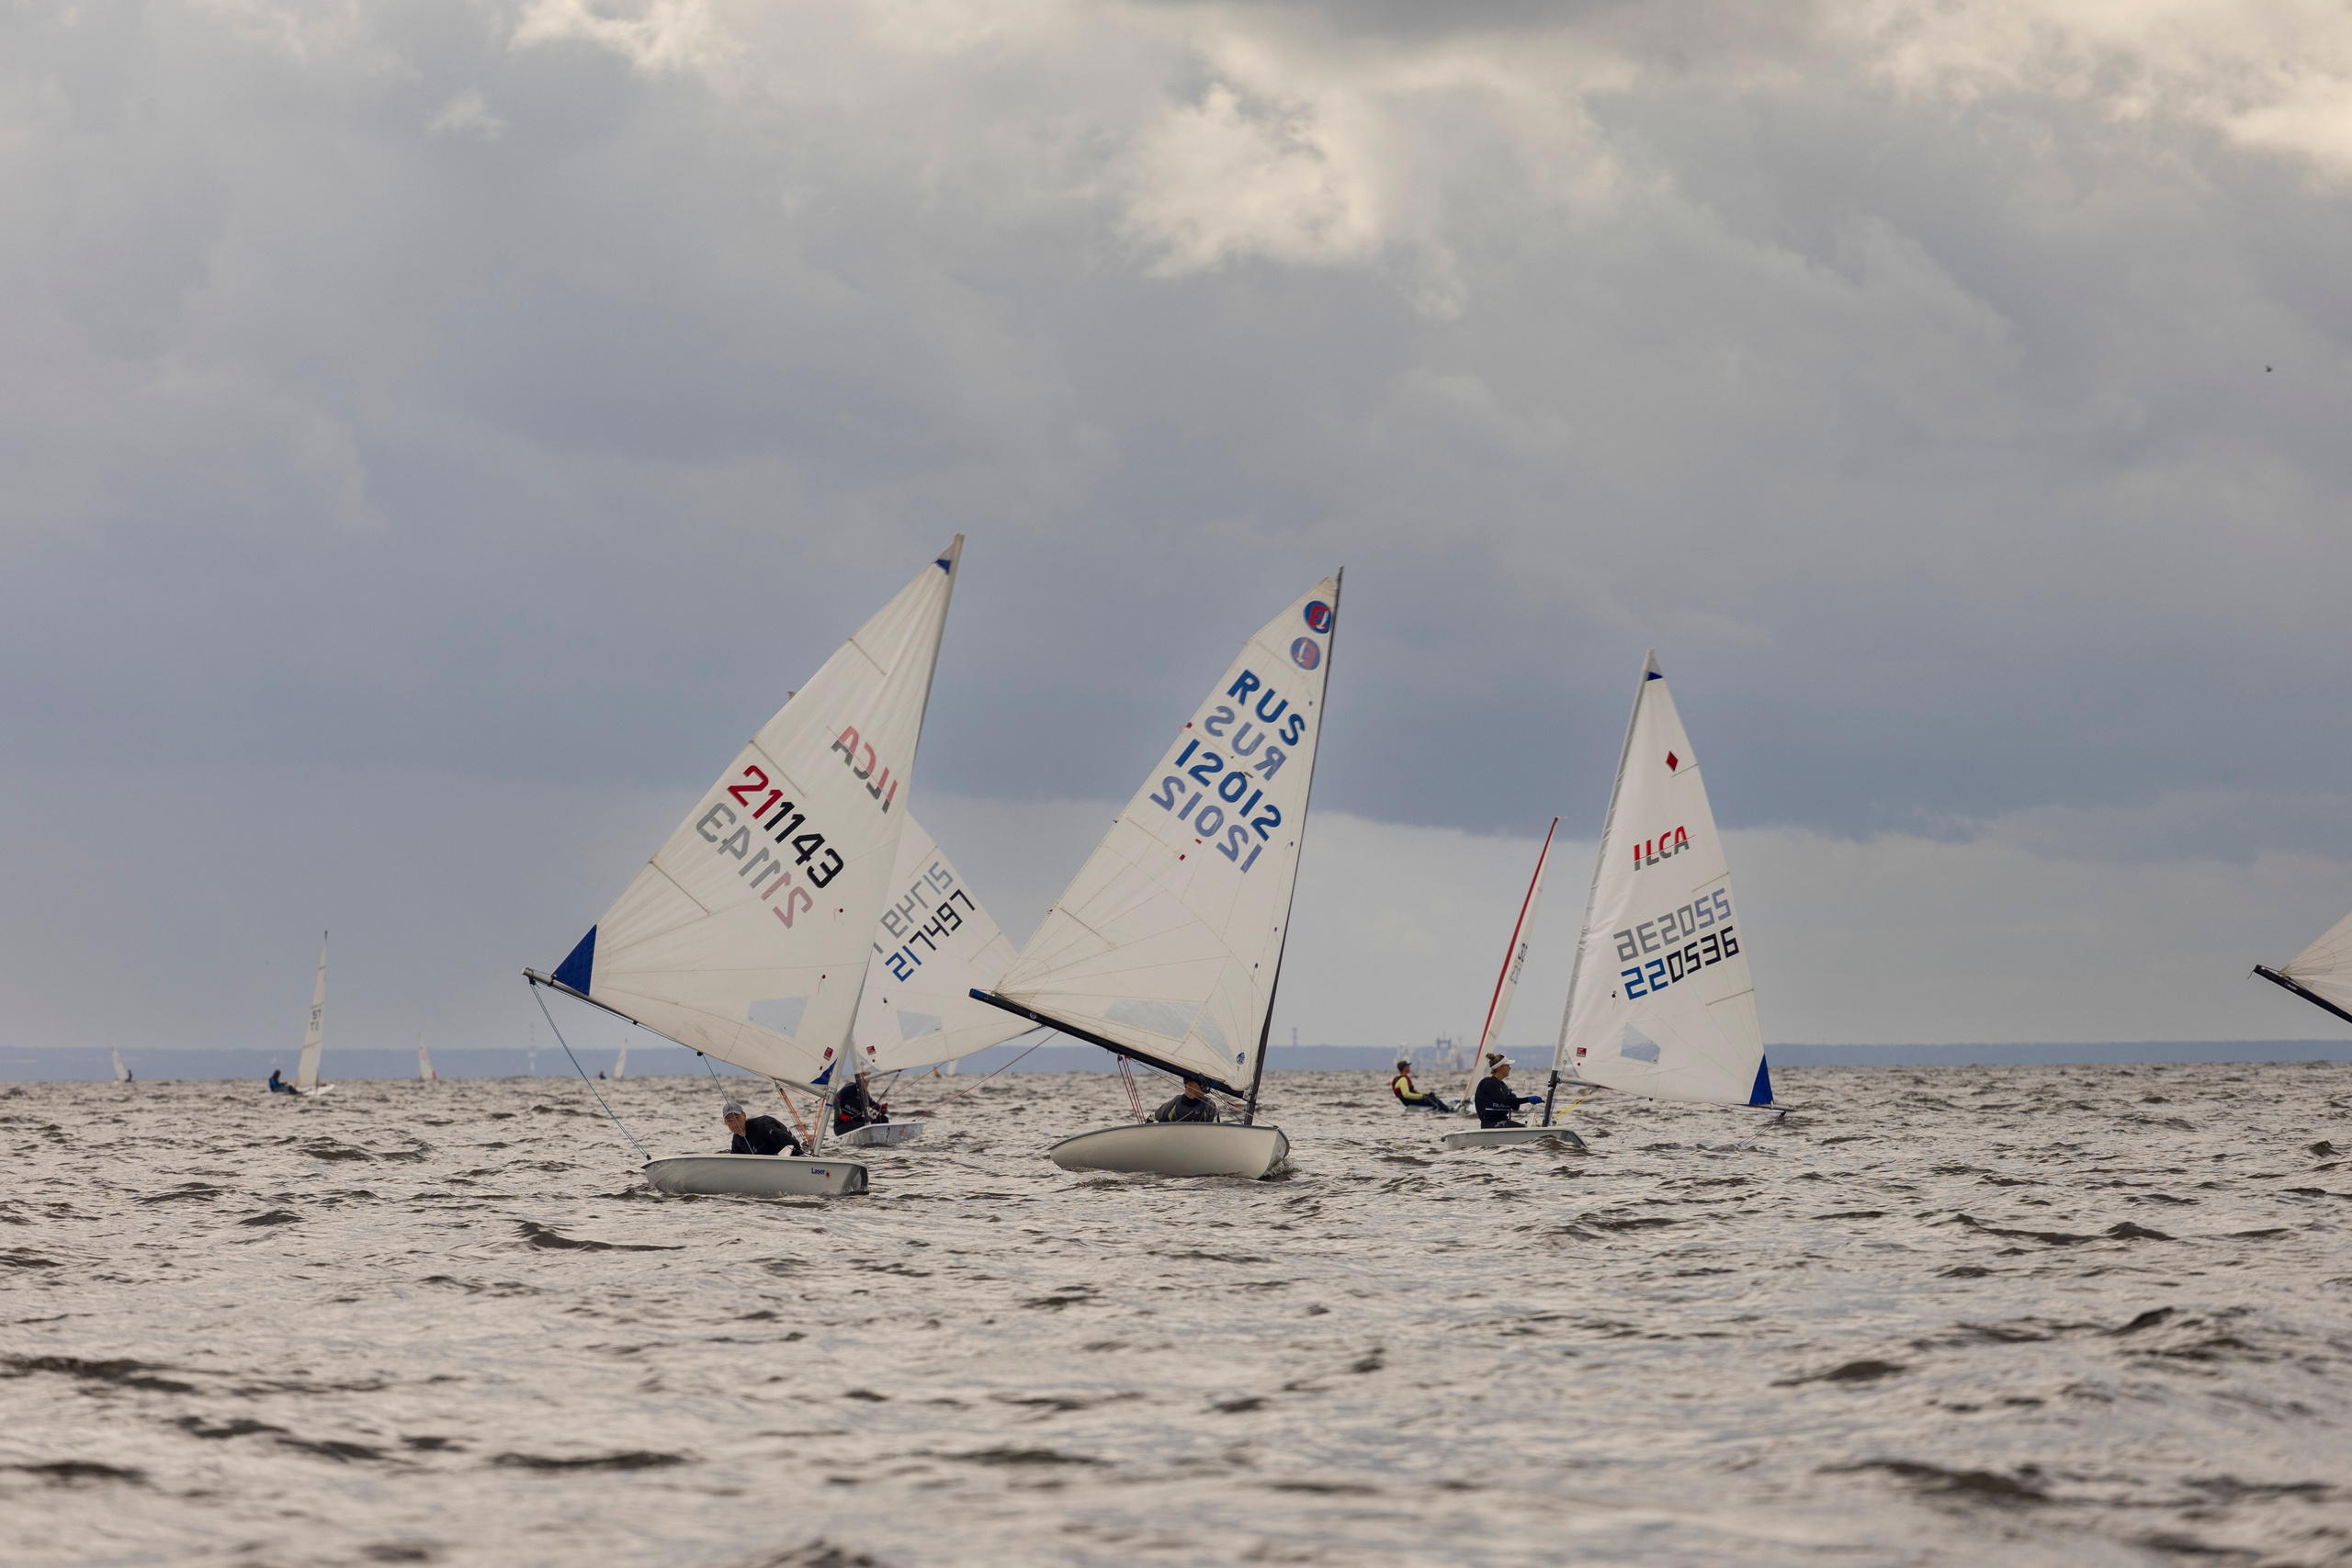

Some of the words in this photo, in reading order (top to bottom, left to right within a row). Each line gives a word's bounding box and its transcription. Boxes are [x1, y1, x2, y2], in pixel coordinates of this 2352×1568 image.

[1226, 669, 1306, 746] RUS
[727, 764, 844, 888] 211143
[1174, 739, 1282, 842] 12012
[1634, 826, 1690, 871] ILCA
[885, 889, 975, 982] 217497
[1621, 925, 1739, 1000] 220536
